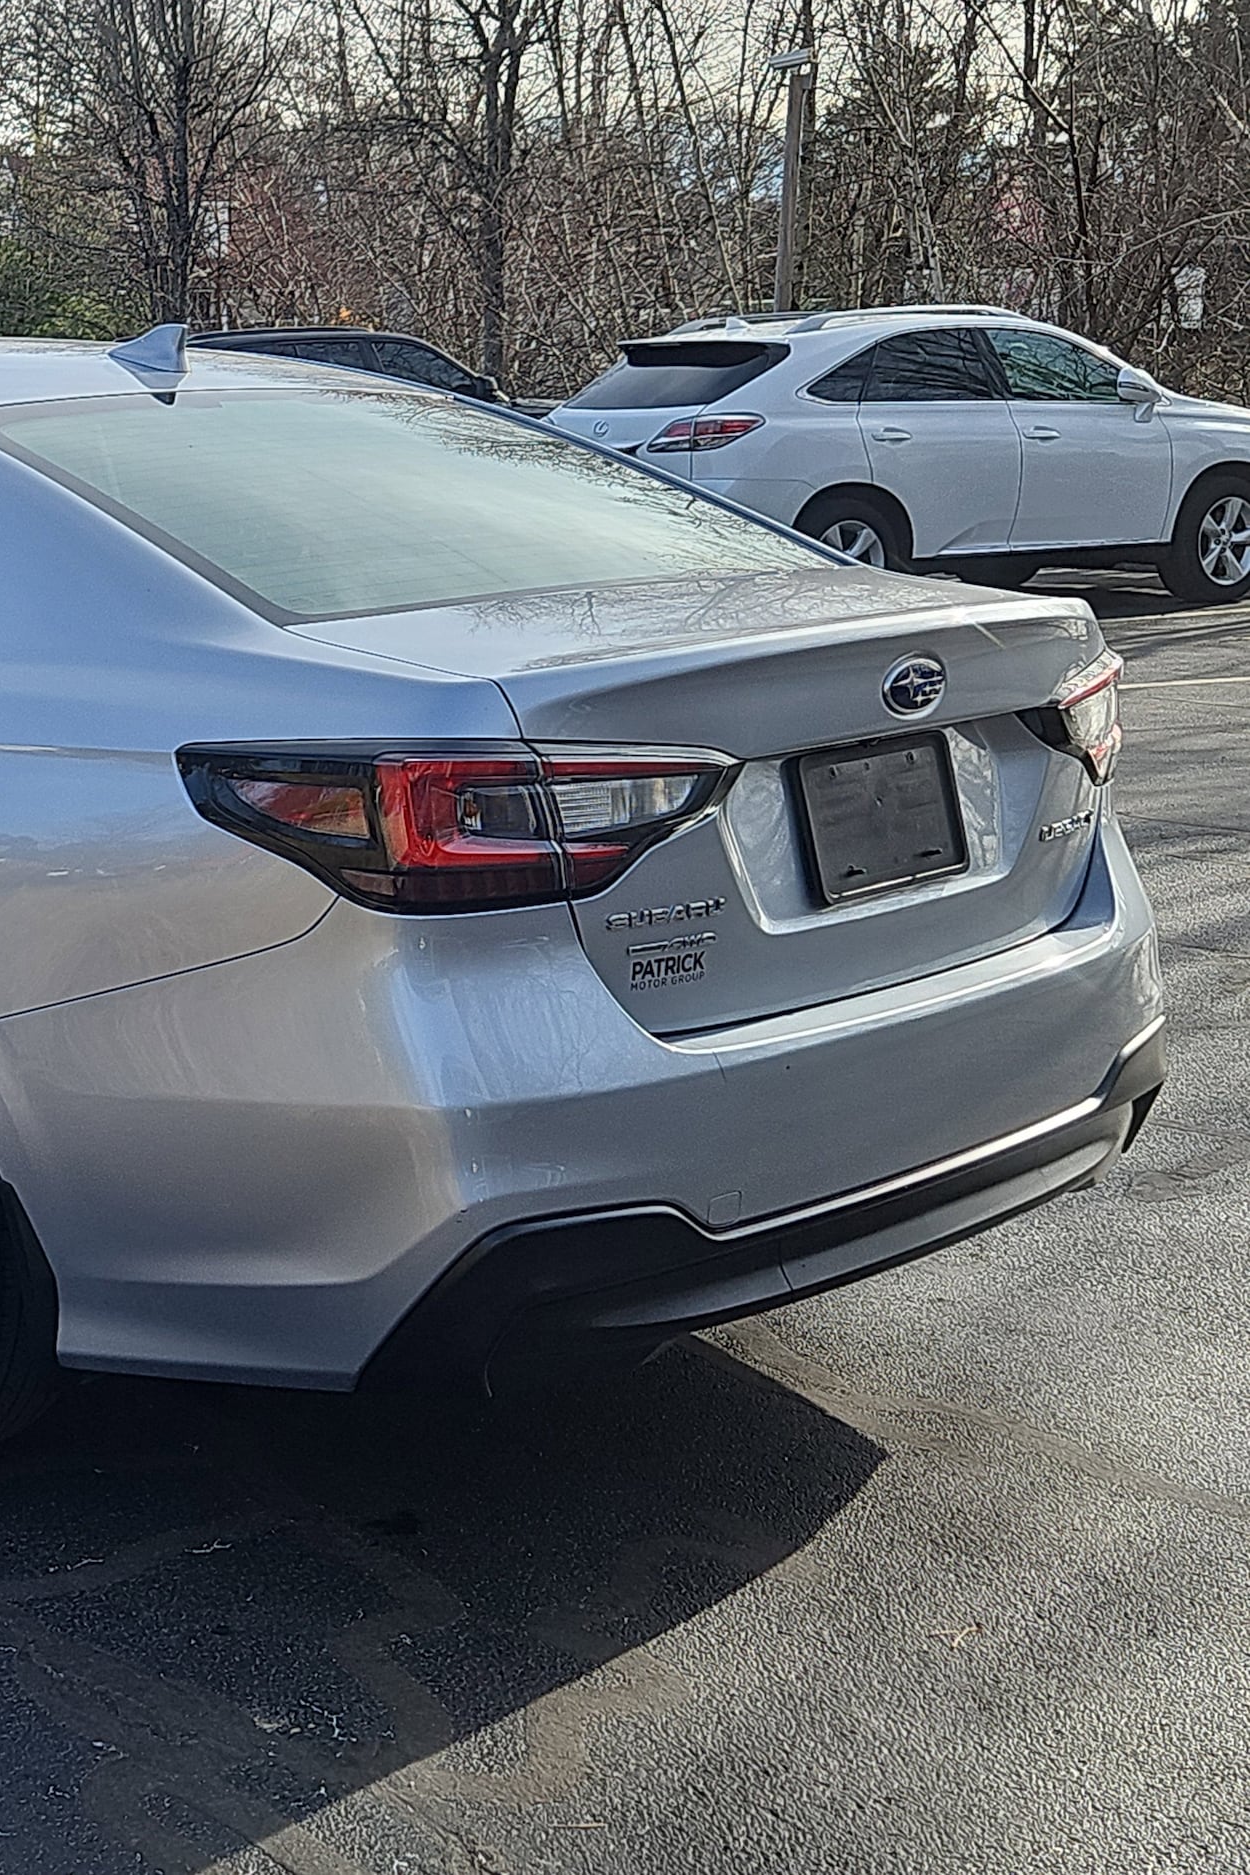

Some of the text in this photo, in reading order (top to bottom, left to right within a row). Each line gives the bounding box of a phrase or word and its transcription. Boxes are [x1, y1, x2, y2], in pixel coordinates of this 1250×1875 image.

[606, 897, 726, 930] SUBARU
[630, 971, 705, 991] MOTOR GROUP
[631, 951, 706, 981] PATRICK
